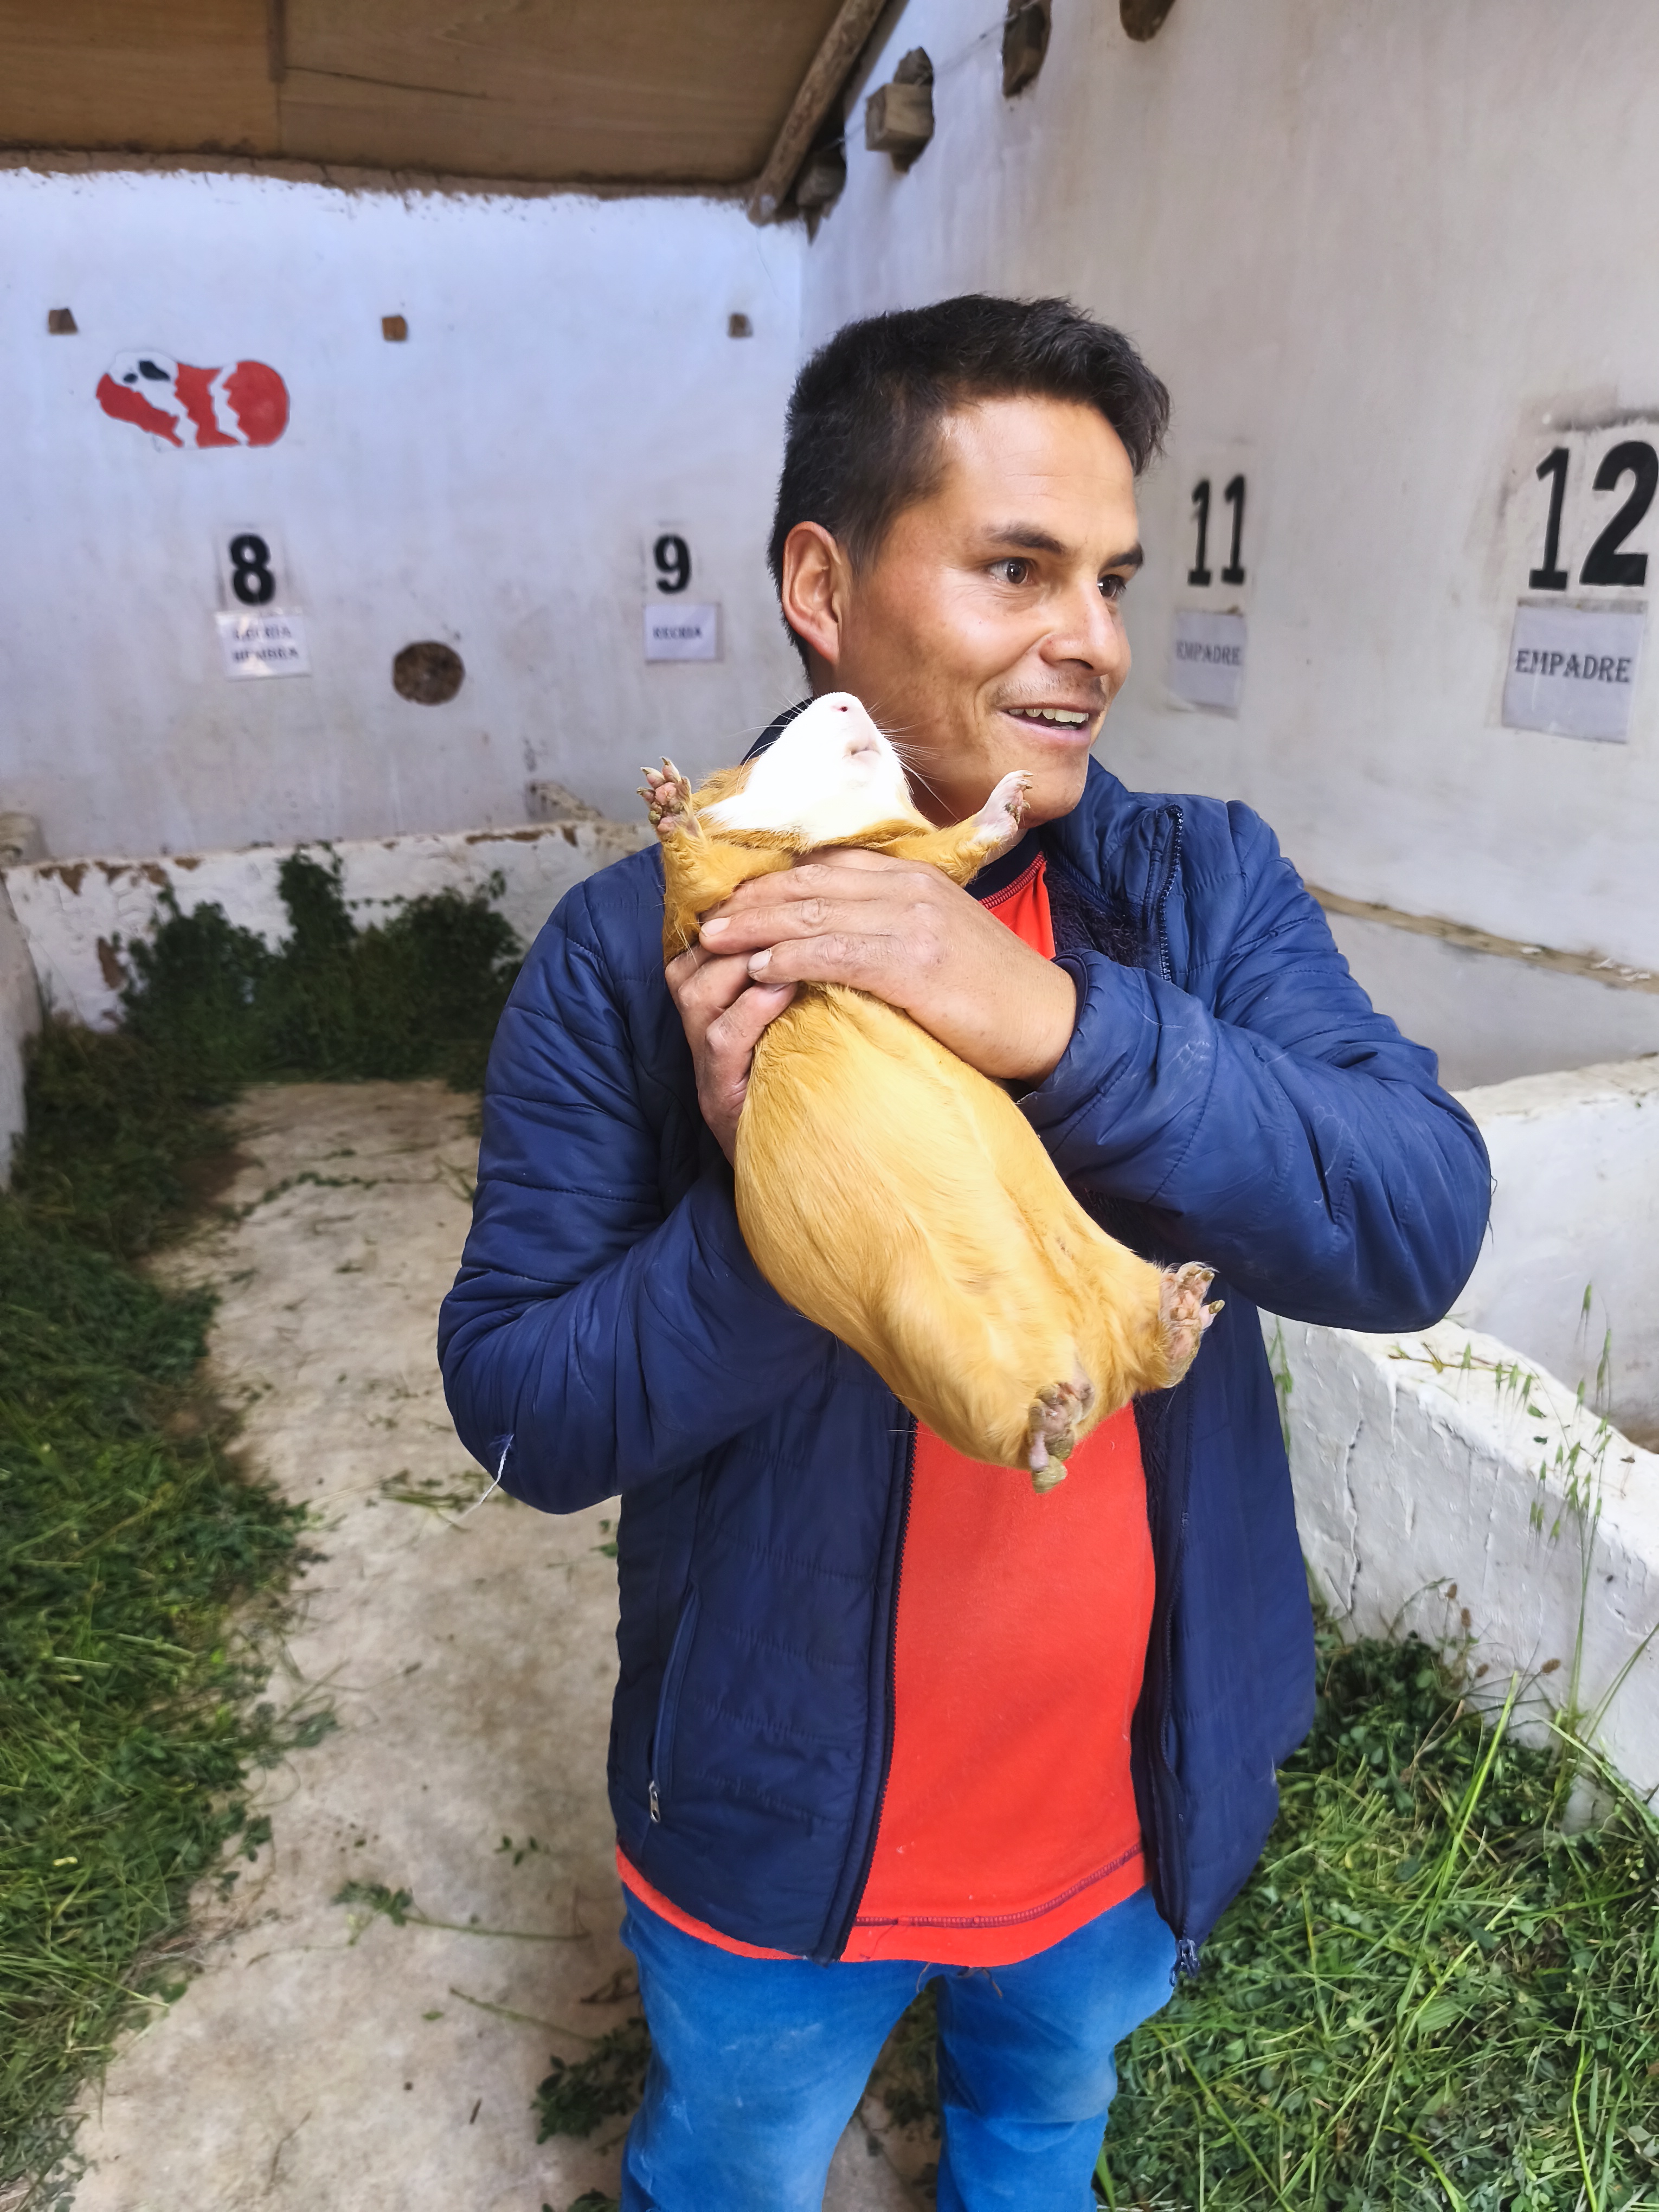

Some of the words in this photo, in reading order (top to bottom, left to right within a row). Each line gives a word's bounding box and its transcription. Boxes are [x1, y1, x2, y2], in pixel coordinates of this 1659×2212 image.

[1188, 474, 1245, 586] 11
[1529, 441, 1659, 591] 12
[228, 533, 276, 606] 8
[653, 534, 691, 594] 9
[1176, 640, 1241, 666] EMPADRE
[1516, 649, 1631, 683] EMPADRE
